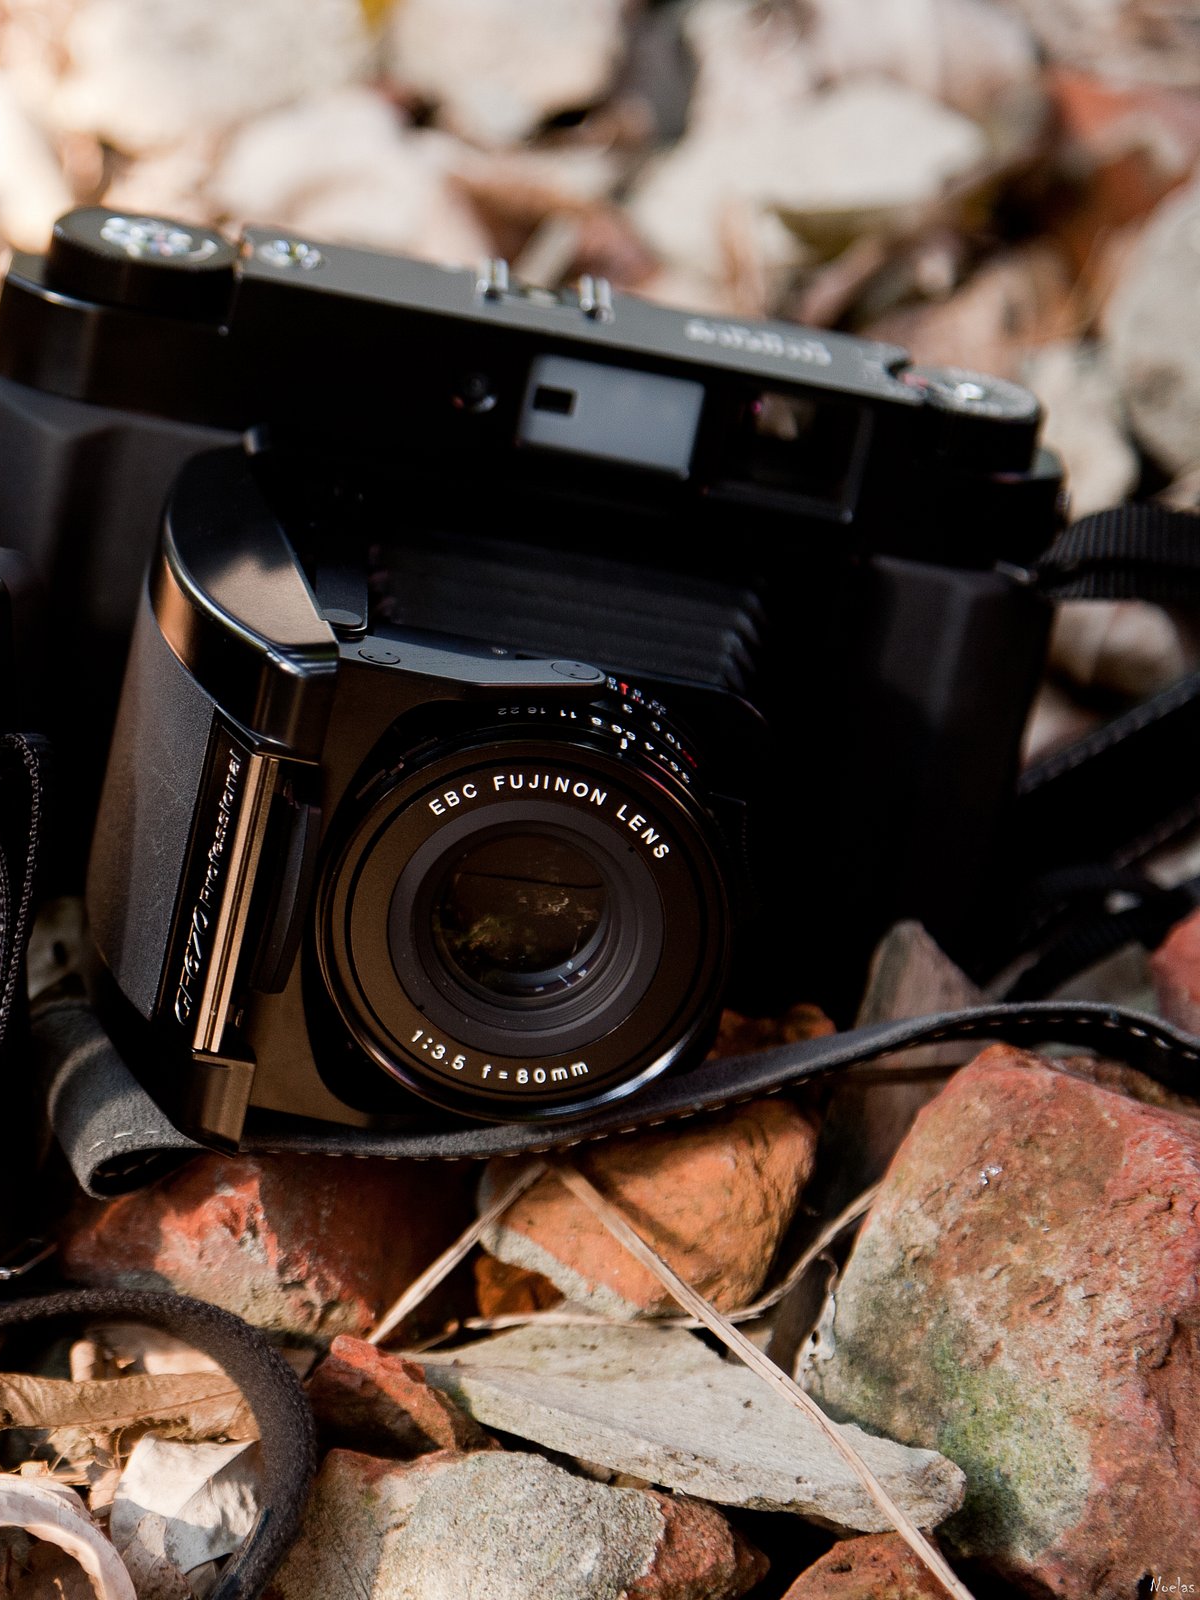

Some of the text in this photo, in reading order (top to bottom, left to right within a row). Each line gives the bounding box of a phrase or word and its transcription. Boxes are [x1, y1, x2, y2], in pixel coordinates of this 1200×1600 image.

[497, 706, 520, 716] 22
[527, 706, 546, 715] 16
[560, 709, 577, 719] 11
[591, 717, 603, 726] 8
[611, 724, 636, 741] 5.6
[429, 774, 670, 860] EBC FUJINON LENS
[200, 748, 241, 909] Professional
[411, 1029, 467, 1071] 1:3.5
